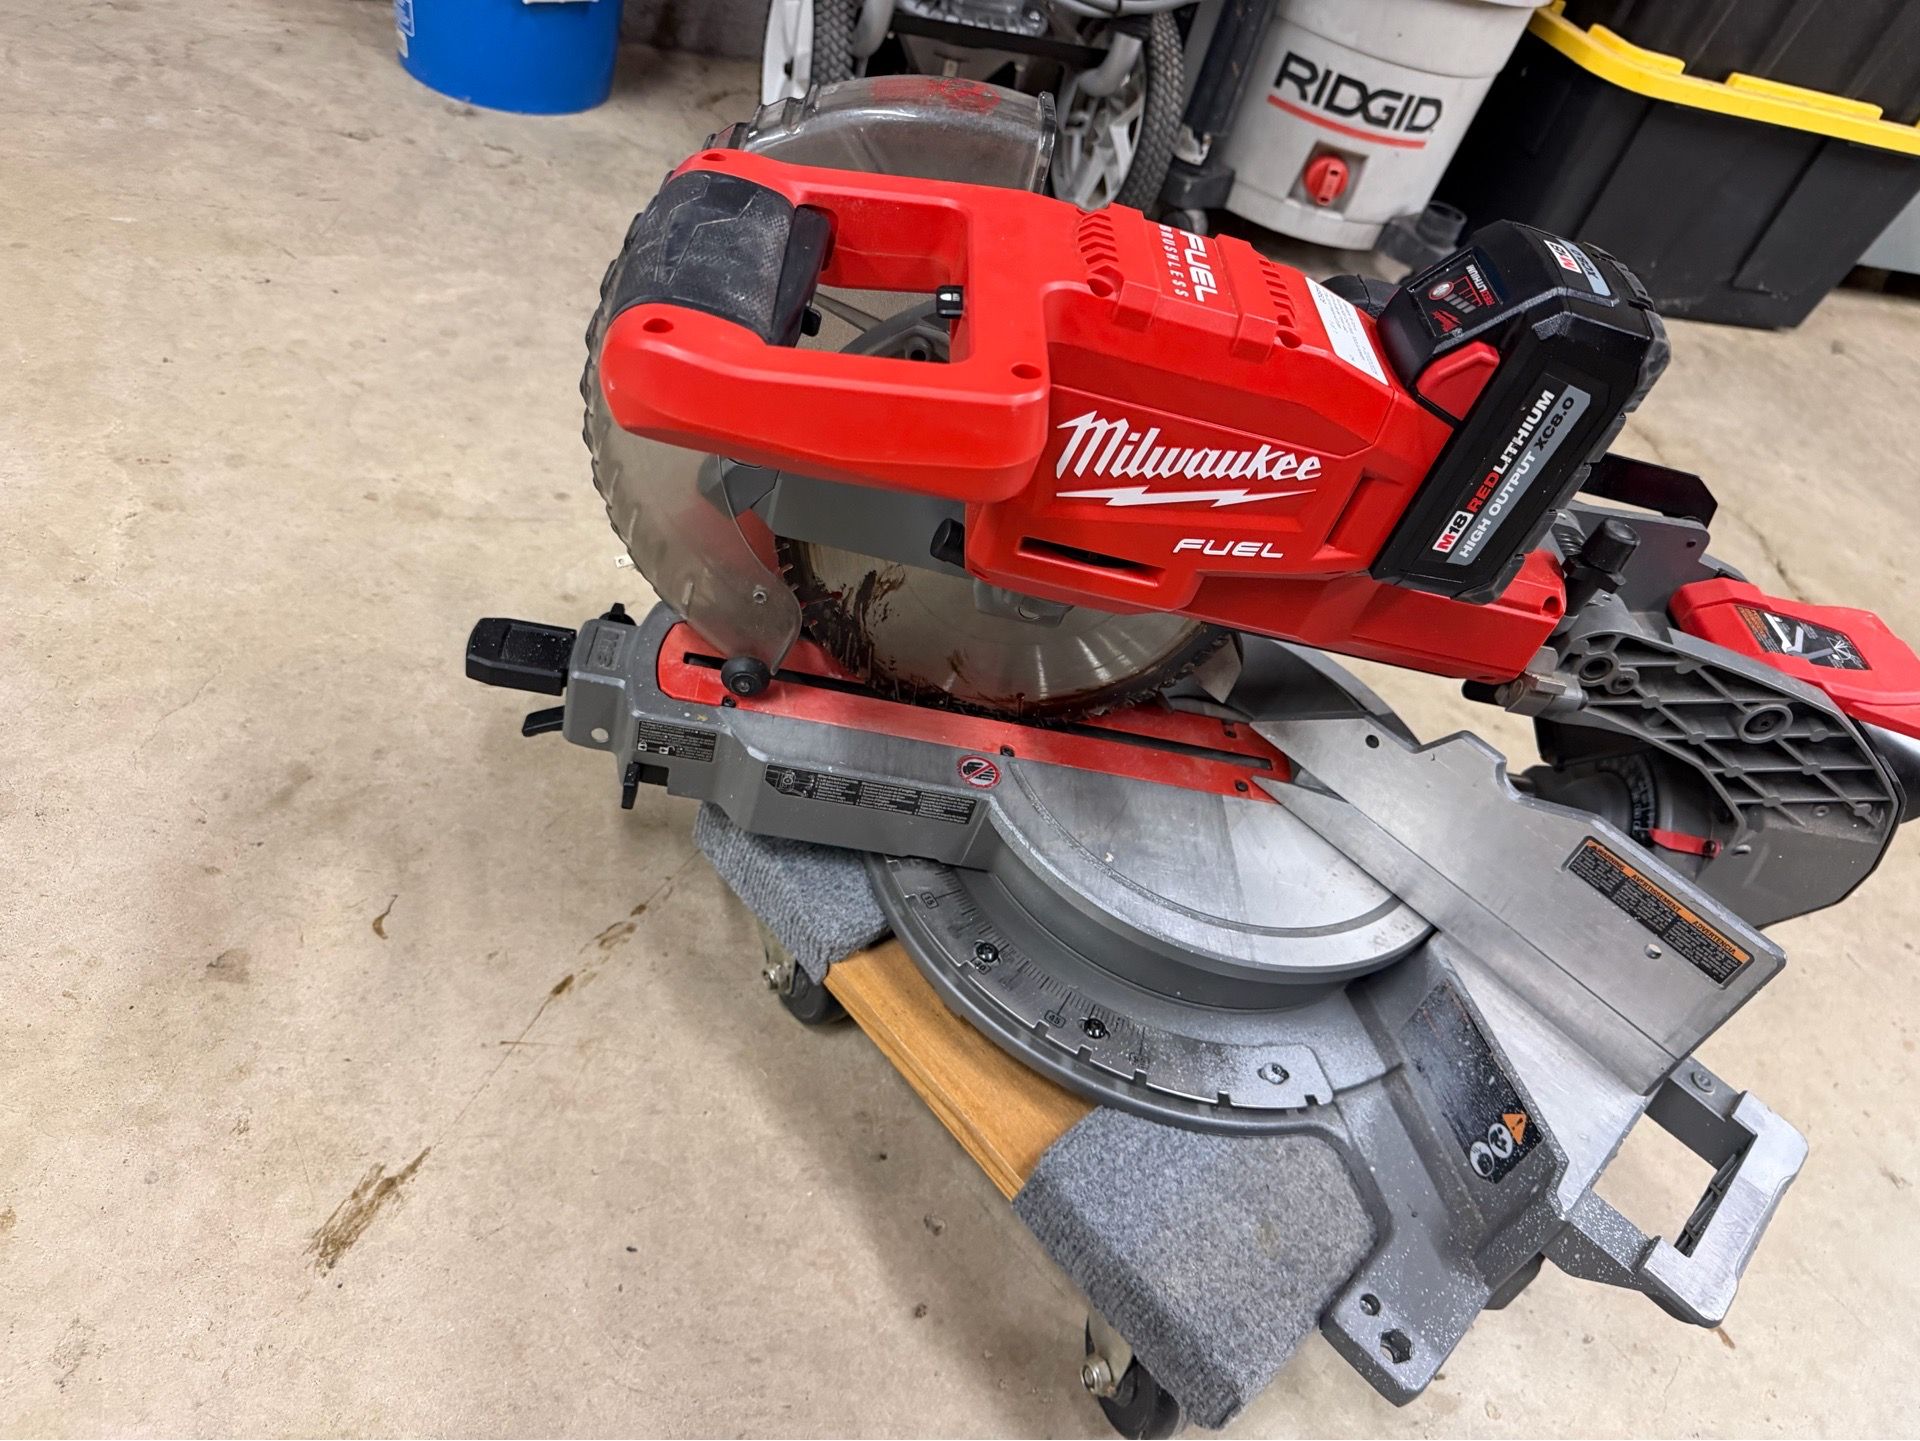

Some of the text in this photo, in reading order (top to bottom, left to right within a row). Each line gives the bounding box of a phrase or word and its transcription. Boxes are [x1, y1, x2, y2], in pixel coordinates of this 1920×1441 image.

[1273, 51, 1443, 134] RIDGID
[1158, 223, 1189, 297] BRUSHLESS
[1179, 229, 1218, 302] FUEL
[1465, 263, 1496, 307] REDLITHIUM
[1055, 409, 1322, 481] Milwaukee
[1436, 389, 1556, 551] M18 REDLITHIUM
[1459, 396, 1576, 558] HIGH OUTPUT XC8.0
[1172, 538, 1284, 559] FUEL
[1596, 846, 1625, 871] WARNING
[1630, 873, 1683, 914] AVERTISSEMENT
[1691, 920, 1737, 956] ADVERTENCIA
